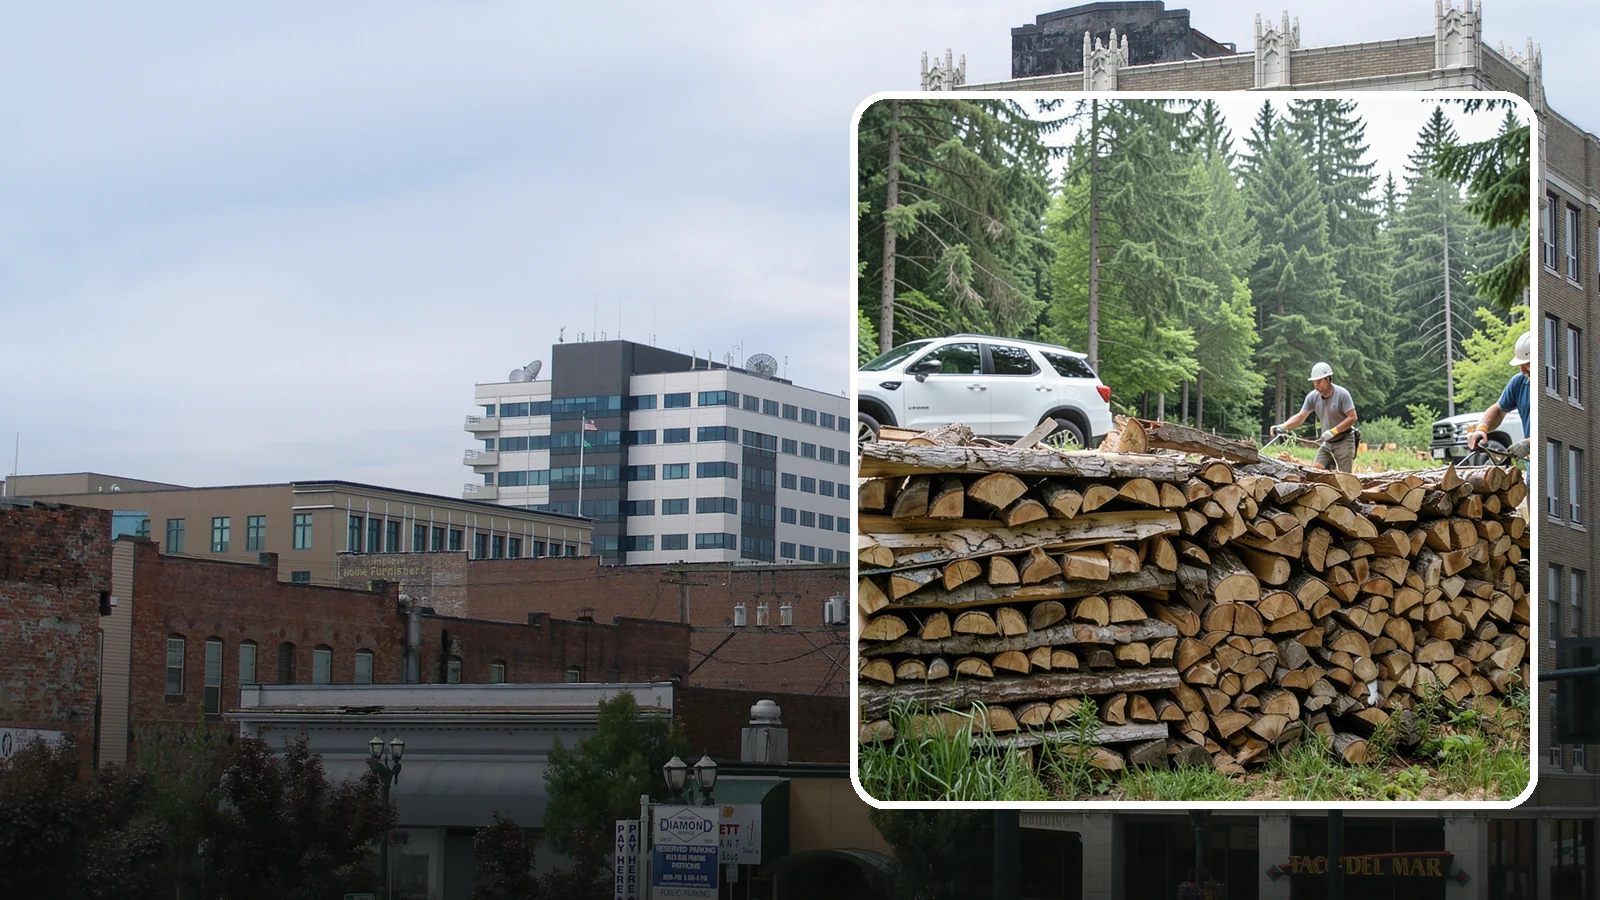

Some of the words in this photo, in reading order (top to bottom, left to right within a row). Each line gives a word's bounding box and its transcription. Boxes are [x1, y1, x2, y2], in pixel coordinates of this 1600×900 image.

[343, 567, 367, 577] Home
[370, 566, 427, 577] Furnishers
[660, 818, 713, 832] DIAMOND
[1022, 815, 1069, 828] BUILDING
[719, 824, 740, 835] ETT
[617, 825, 625, 852] PAY
[628, 824, 636, 852] PAY
[719, 839, 740, 848] ANT
[656, 845, 688, 853] RESERVED
[721, 851, 739, 862] Soup
[1288, 855, 1330, 874] TAC
[1345, 856, 1385, 876] DEL
[1392, 857, 1443, 877] MAR
[616, 856, 625, 893] HERE
[627, 856, 636, 893] HERE
[660, 888, 682, 897] PUBLIC
[684, 889, 710, 898] PARKING
